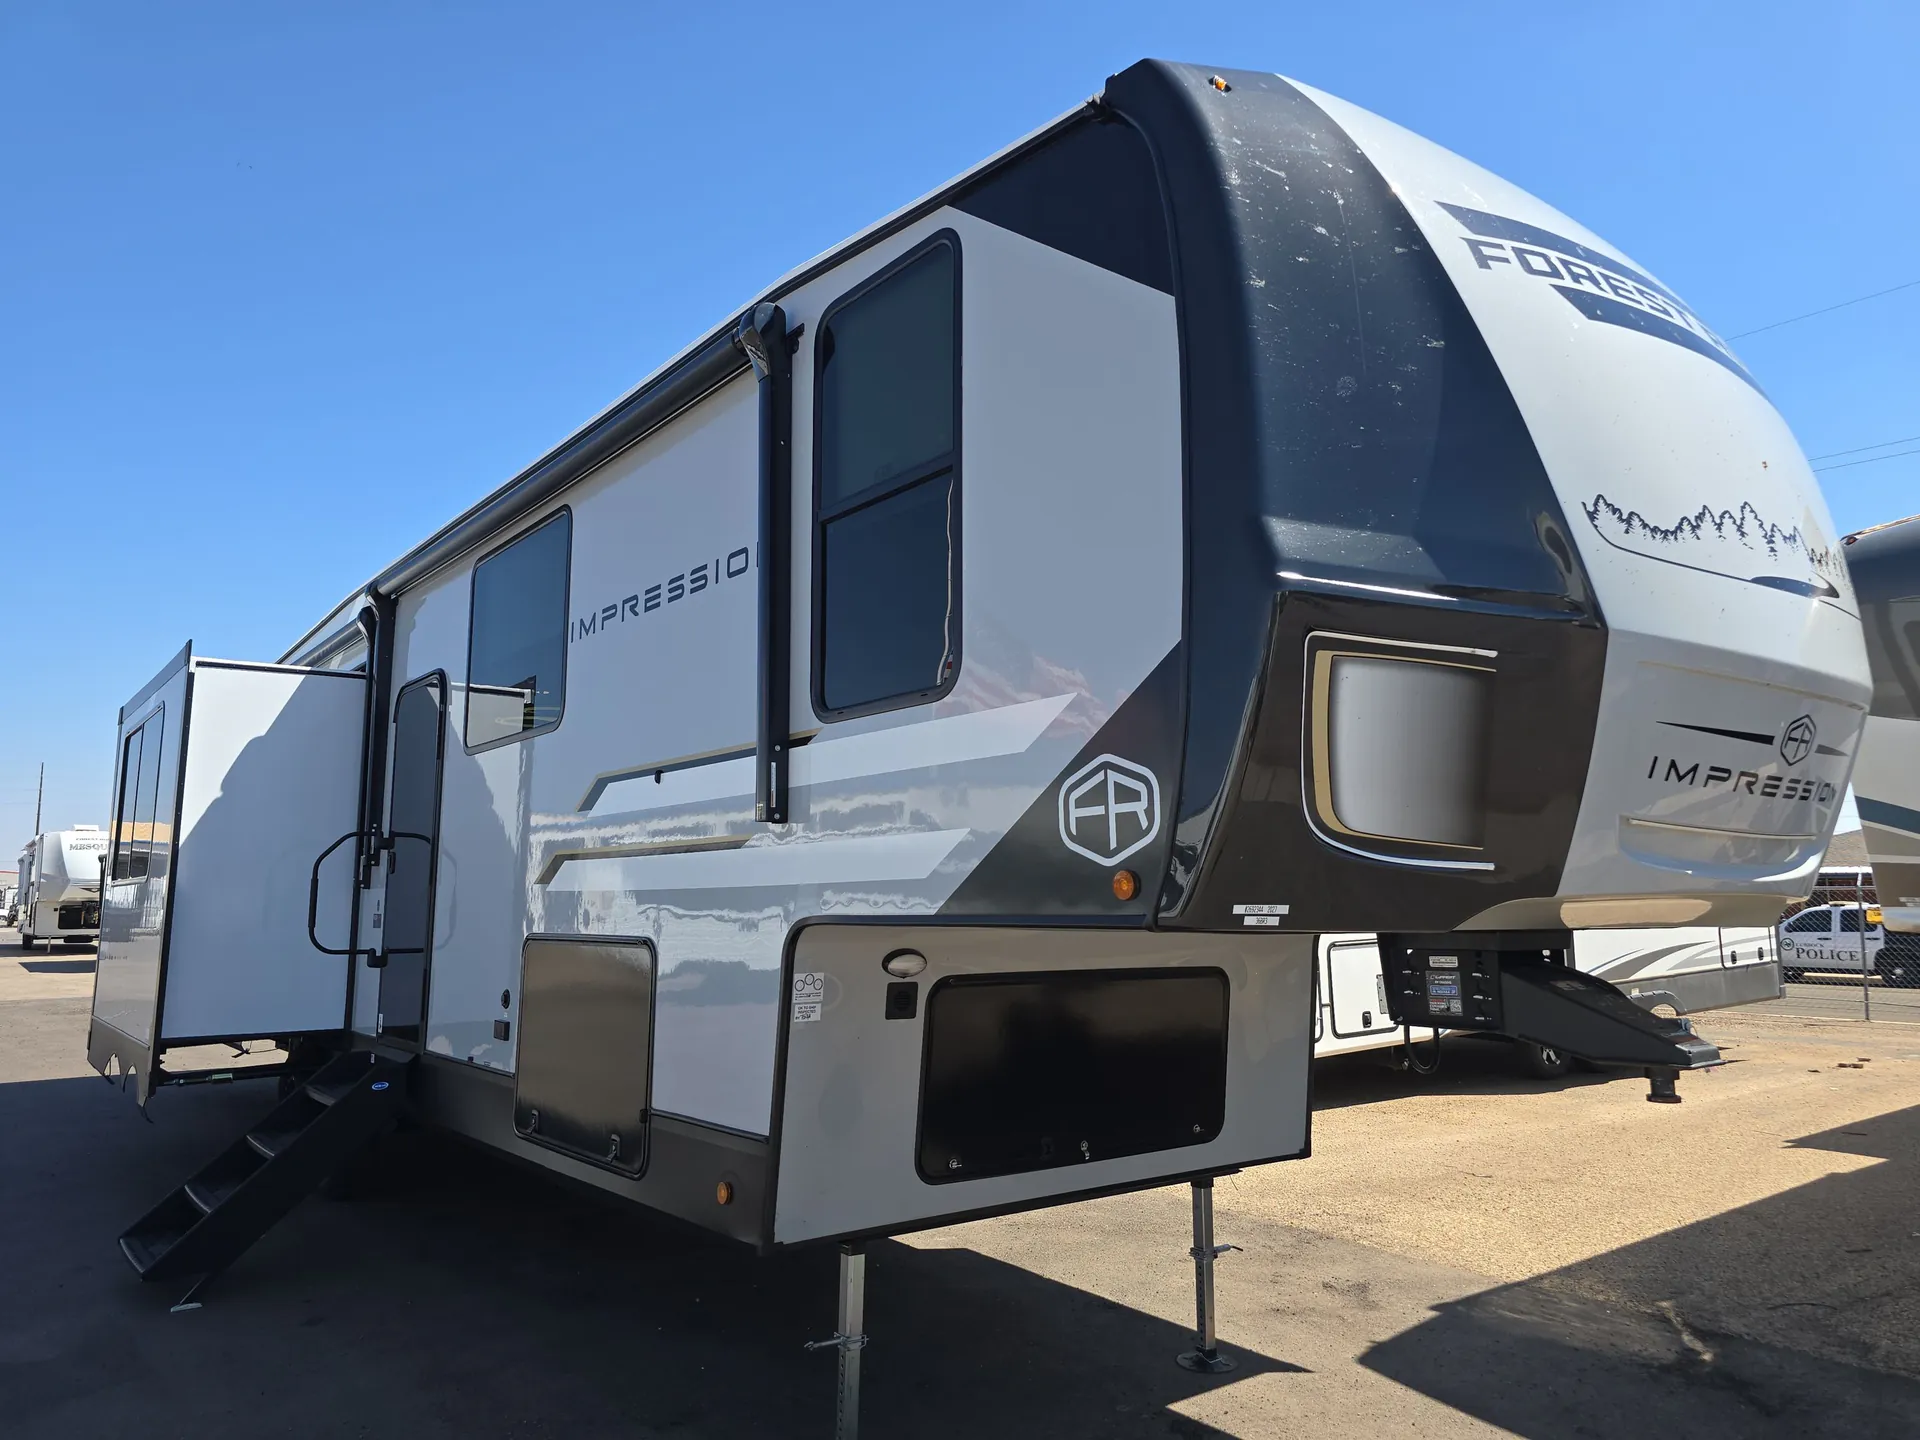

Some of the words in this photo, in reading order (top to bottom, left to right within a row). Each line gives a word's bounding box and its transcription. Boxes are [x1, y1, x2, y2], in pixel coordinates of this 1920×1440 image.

[570, 541, 759, 644] IMPRESSIO
[1647, 756, 1837, 802] IMPRESSION
[1796, 947, 1860, 962] POLICE
